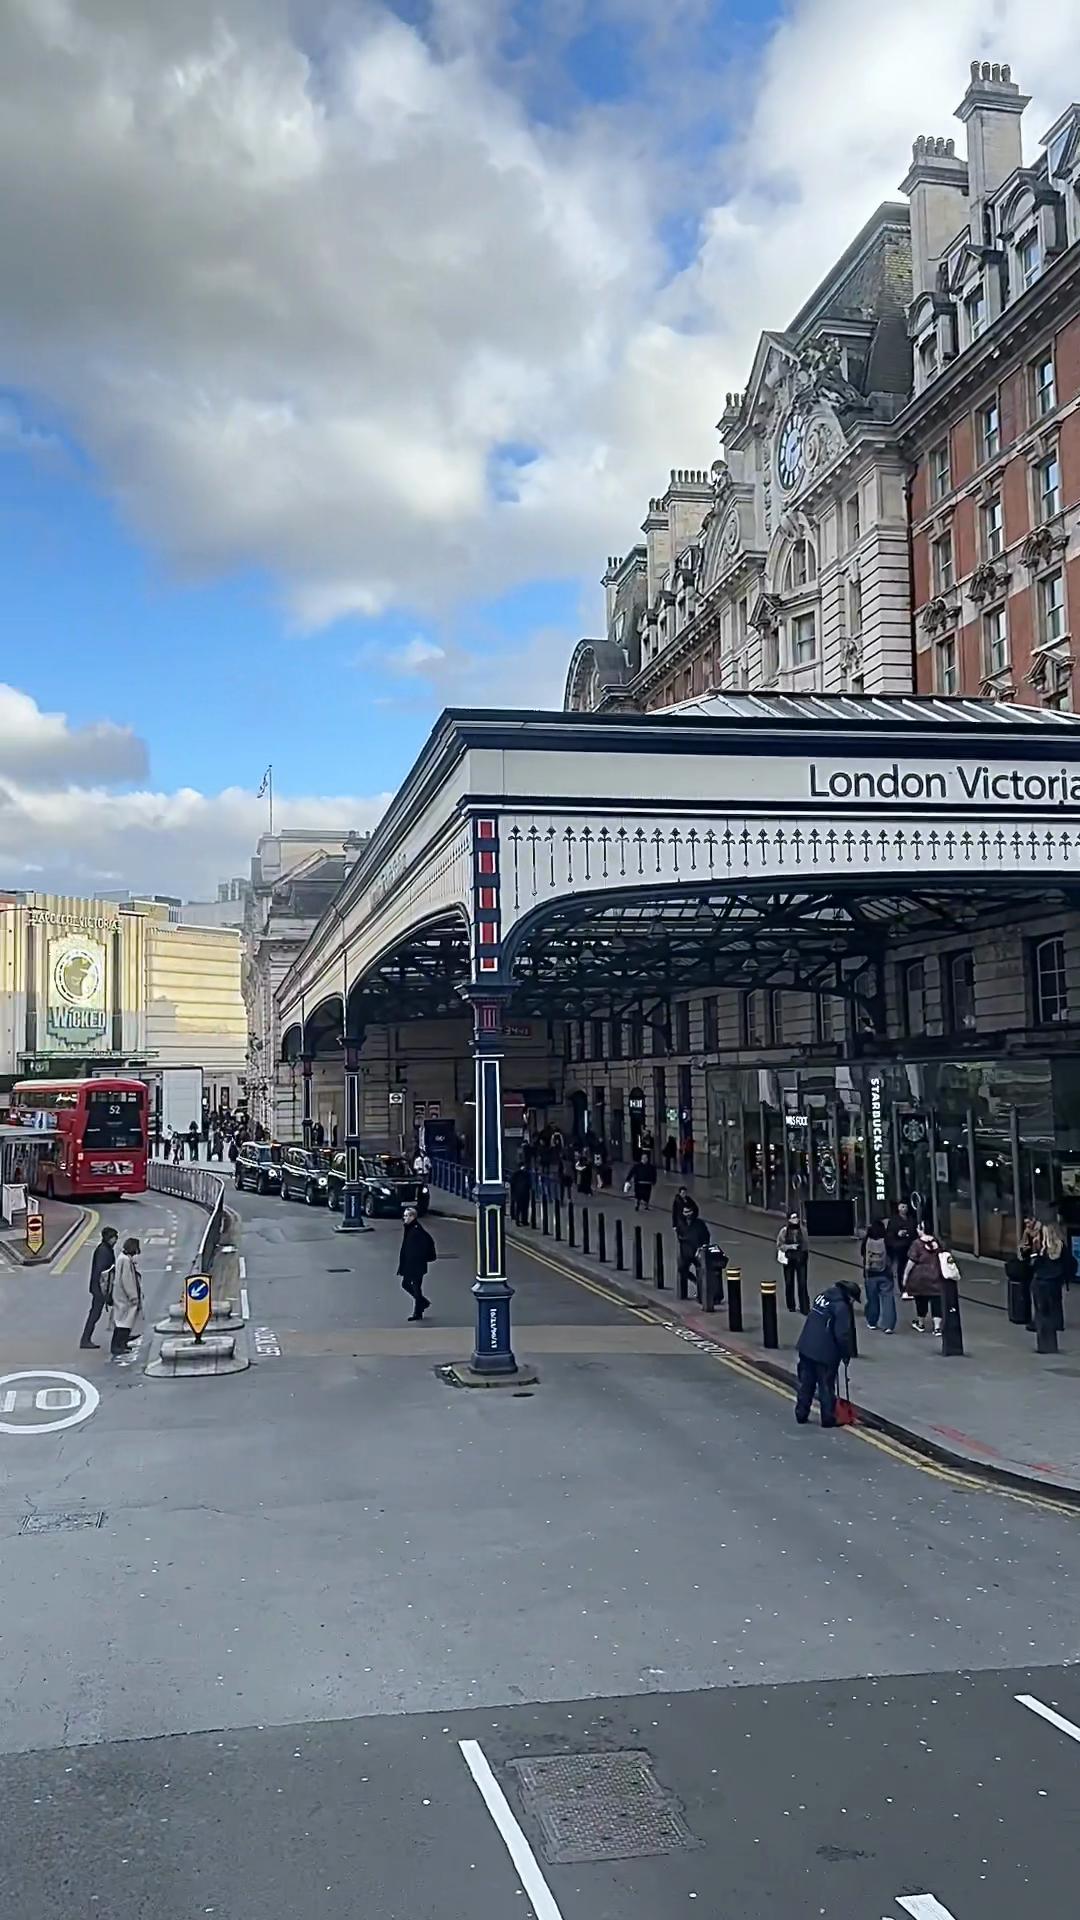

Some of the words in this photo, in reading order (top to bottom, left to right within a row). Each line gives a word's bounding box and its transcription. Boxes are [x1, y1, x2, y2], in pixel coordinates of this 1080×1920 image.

[809, 763, 947, 799] London
[109, 1105, 120, 1114] 52
[871, 1078, 882, 1152] STARBUCKS
[874, 1154, 885, 1201] COFFEE
